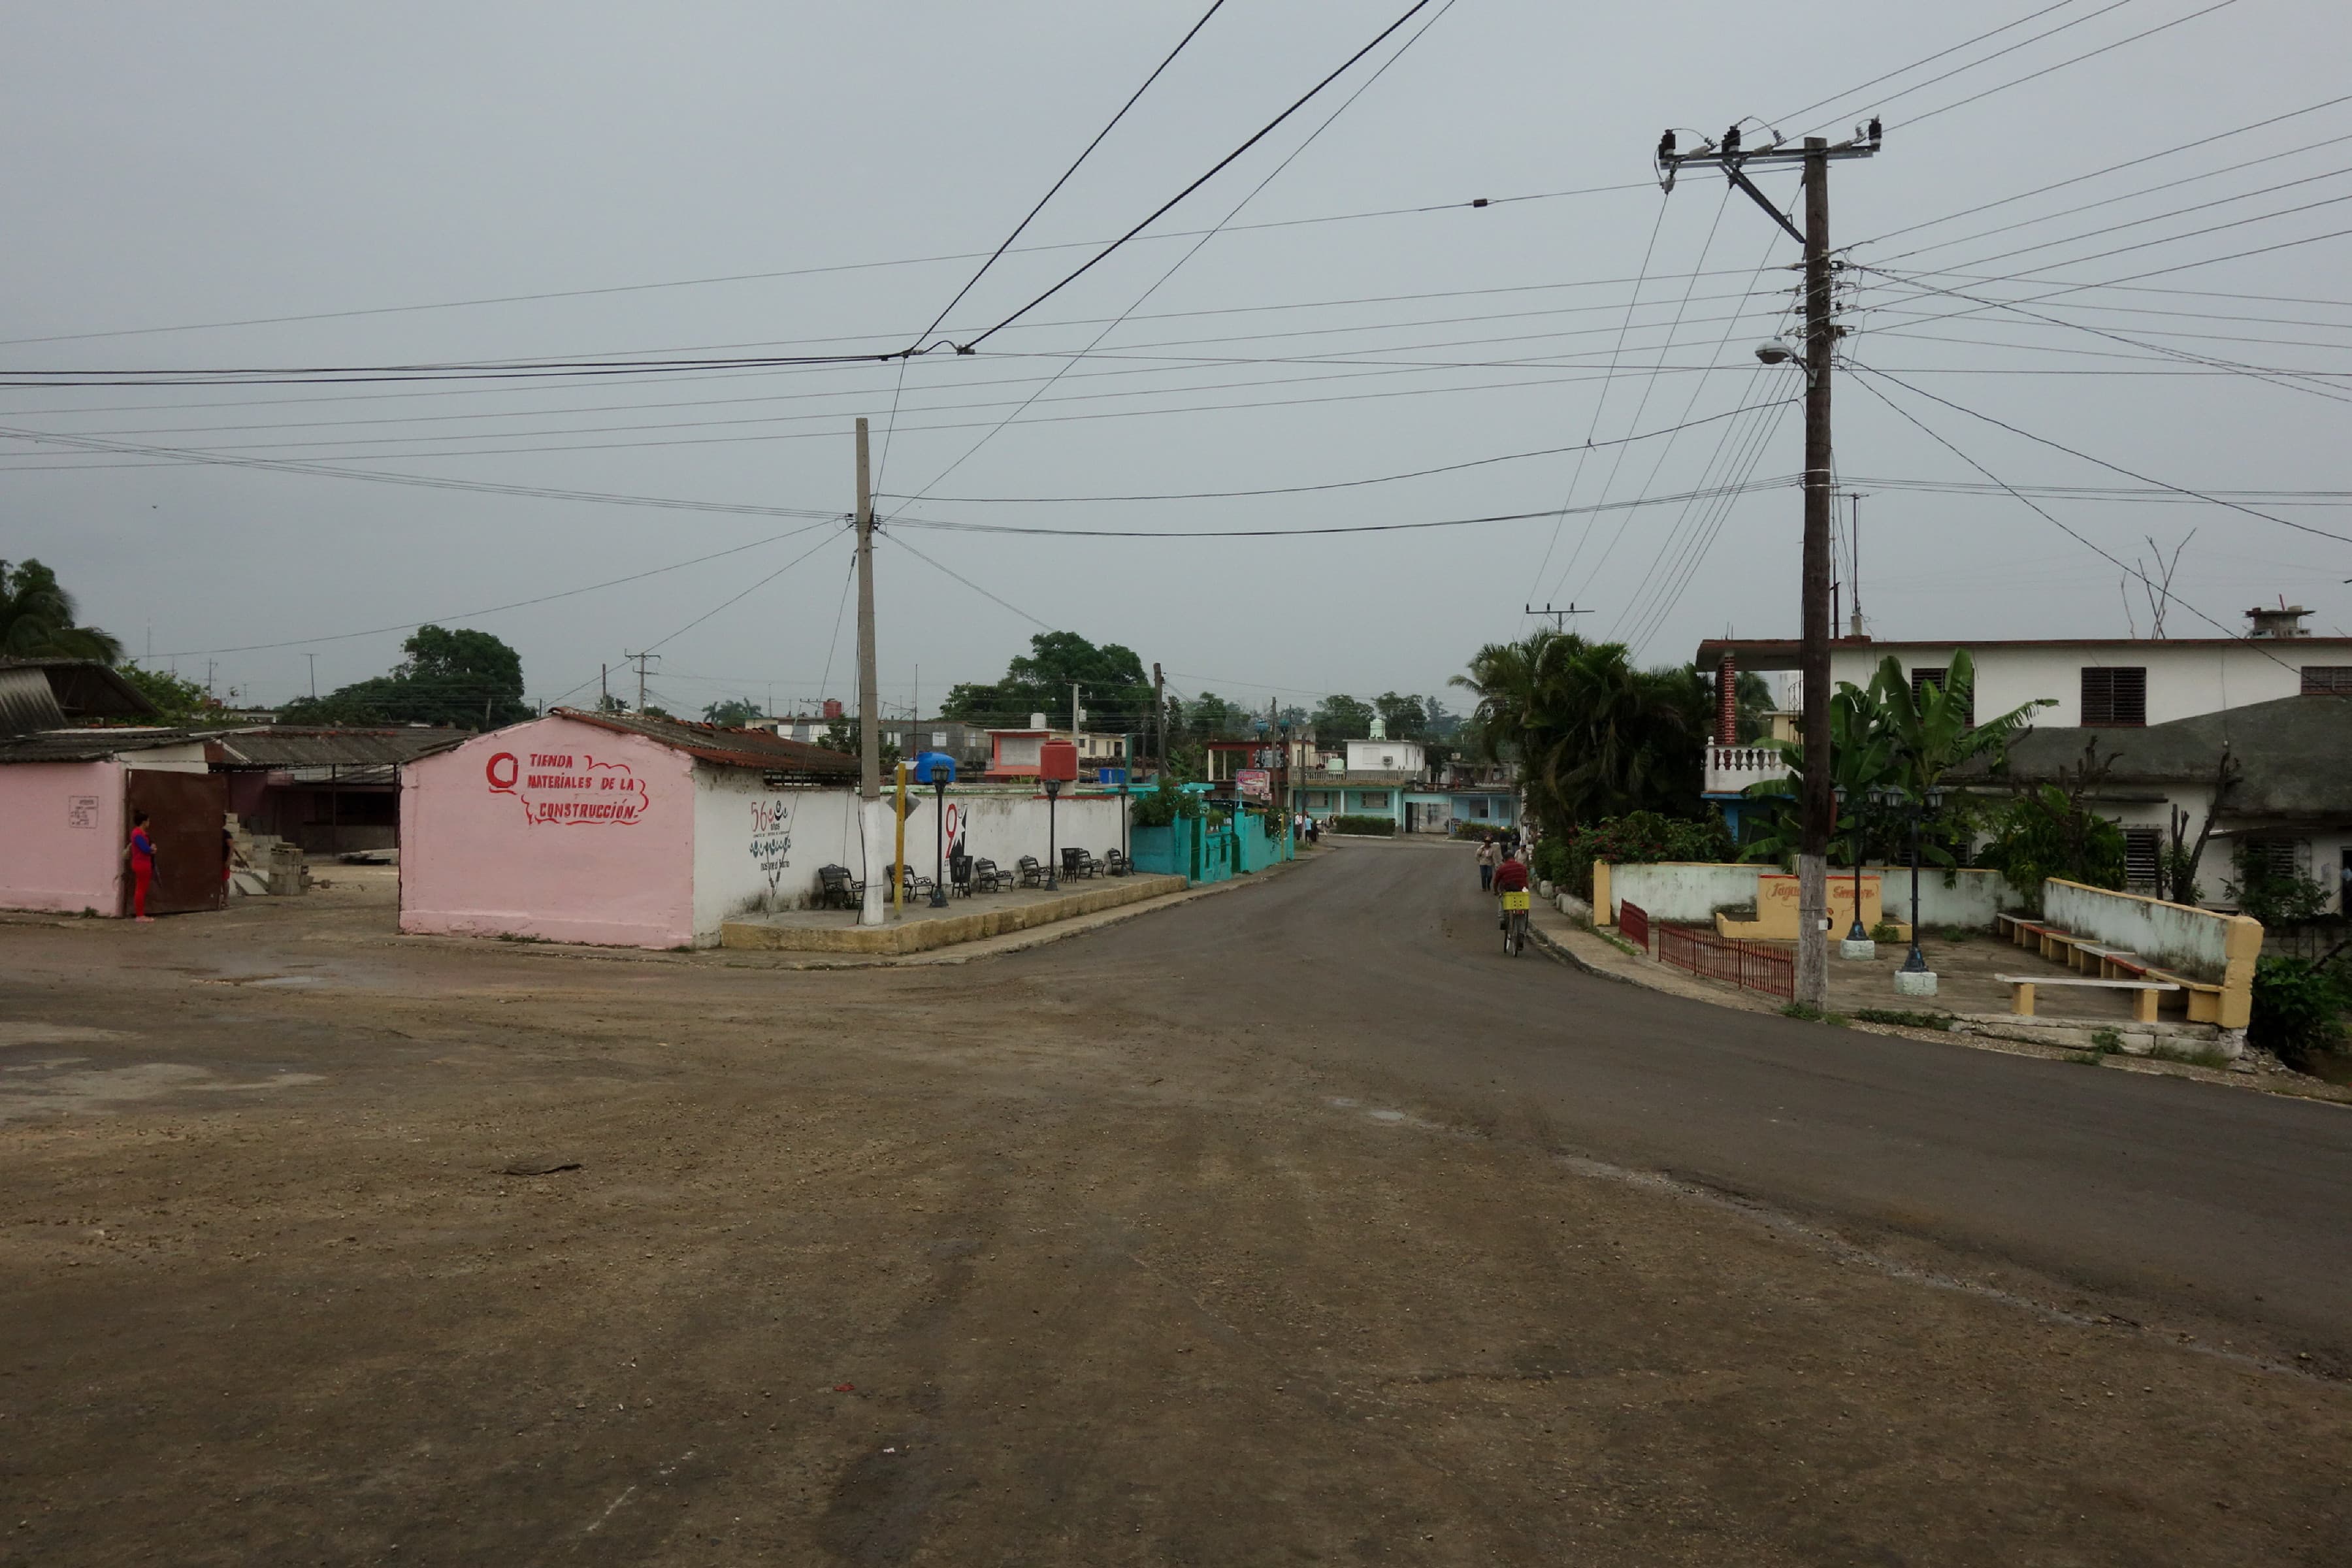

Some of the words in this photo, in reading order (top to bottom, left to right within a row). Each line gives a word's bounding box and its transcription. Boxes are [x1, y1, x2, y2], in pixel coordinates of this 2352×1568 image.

[530, 754, 573, 768] TIENDA
[527, 772, 593, 789] MATERIALES
[600, 777, 615, 790] DE
[621, 777, 634, 791] LA
